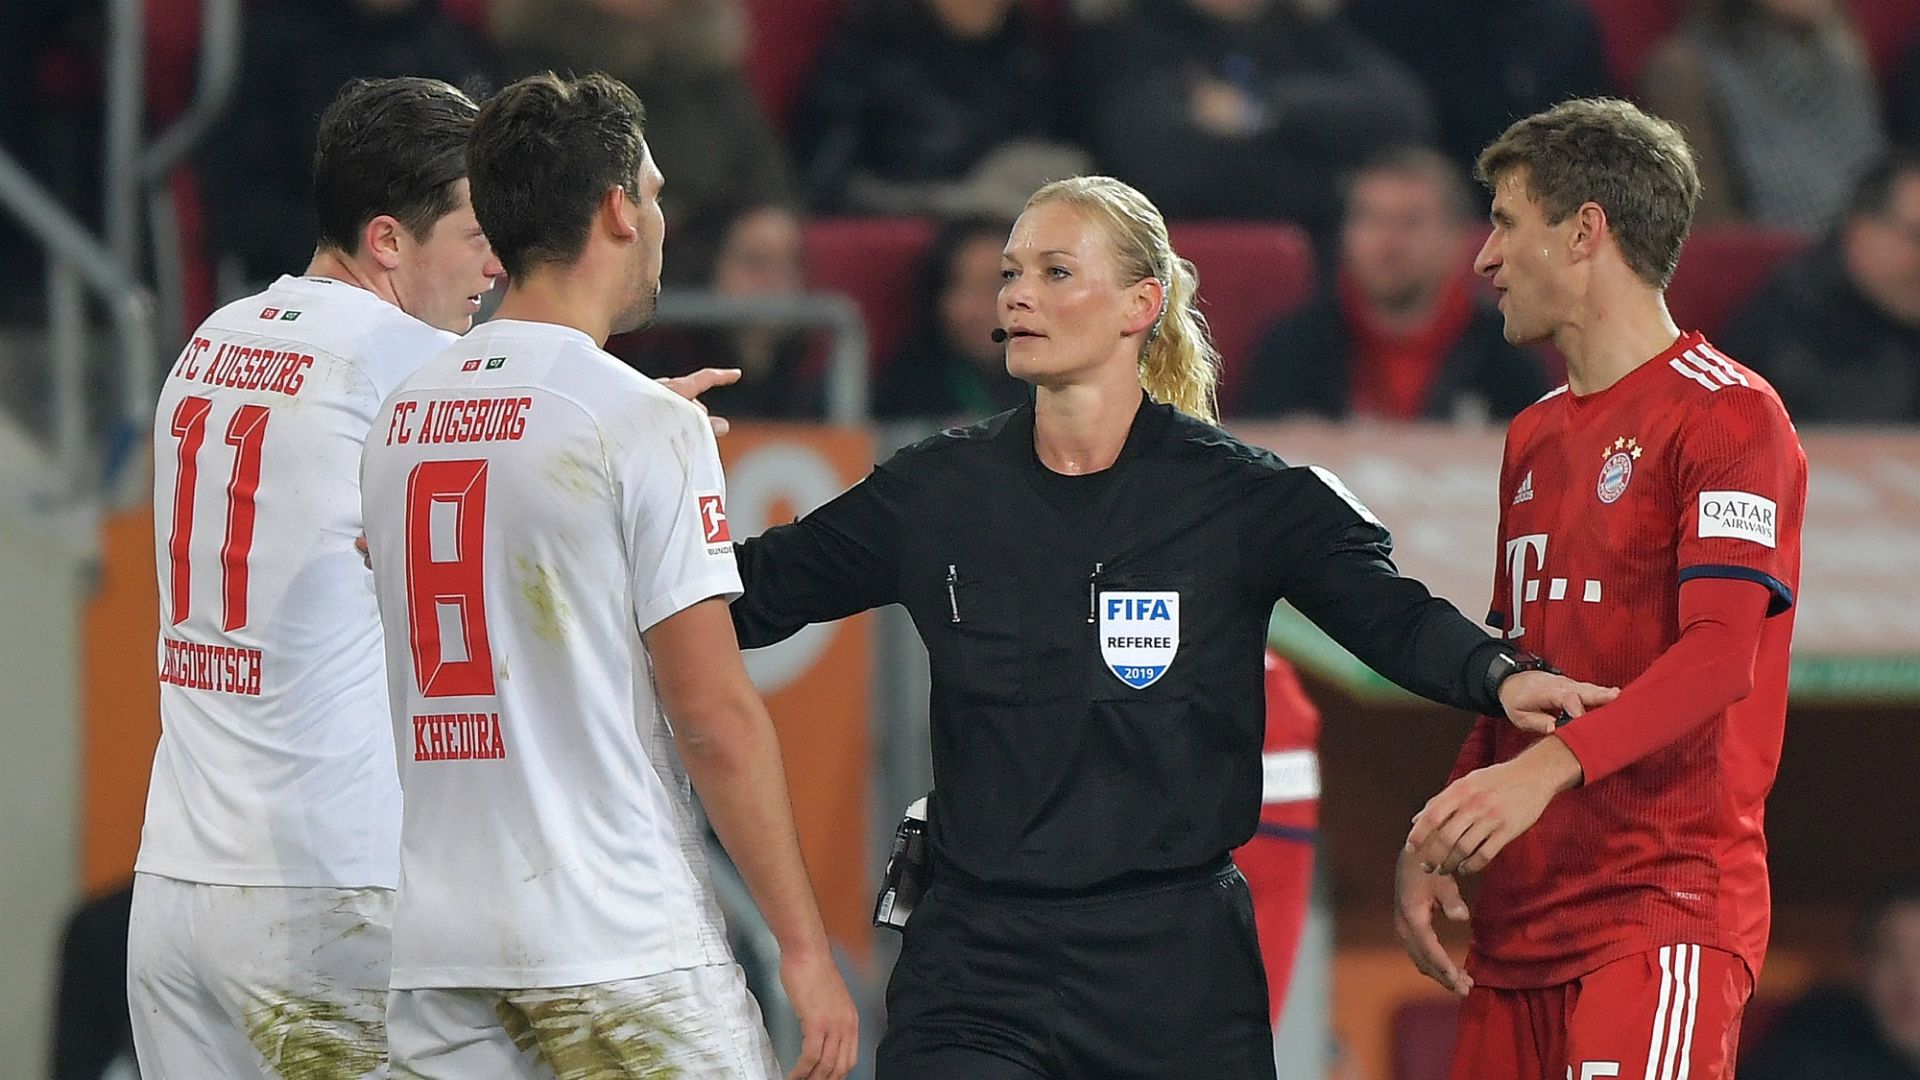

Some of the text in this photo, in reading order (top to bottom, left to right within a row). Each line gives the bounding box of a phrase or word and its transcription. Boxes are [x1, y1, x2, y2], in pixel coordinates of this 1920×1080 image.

[175, 337, 314, 396] FC AUGSBURG
[386, 397, 532, 446] FC AUGSBURG
[169, 395, 272, 631] 11
[1703, 500, 1772, 527] QATAR
[1722, 518, 1772, 538] AIRWAYS
[707, 546, 734, 556] BUNDE
[405, 458, 497, 697] 8
[1107, 599, 1171, 621] FIFA
[1107, 637, 1171, 649] REFEREE
[1124, 667, 1154, 680] 2019
[412, 712, 506, 761] KHEDIRA
